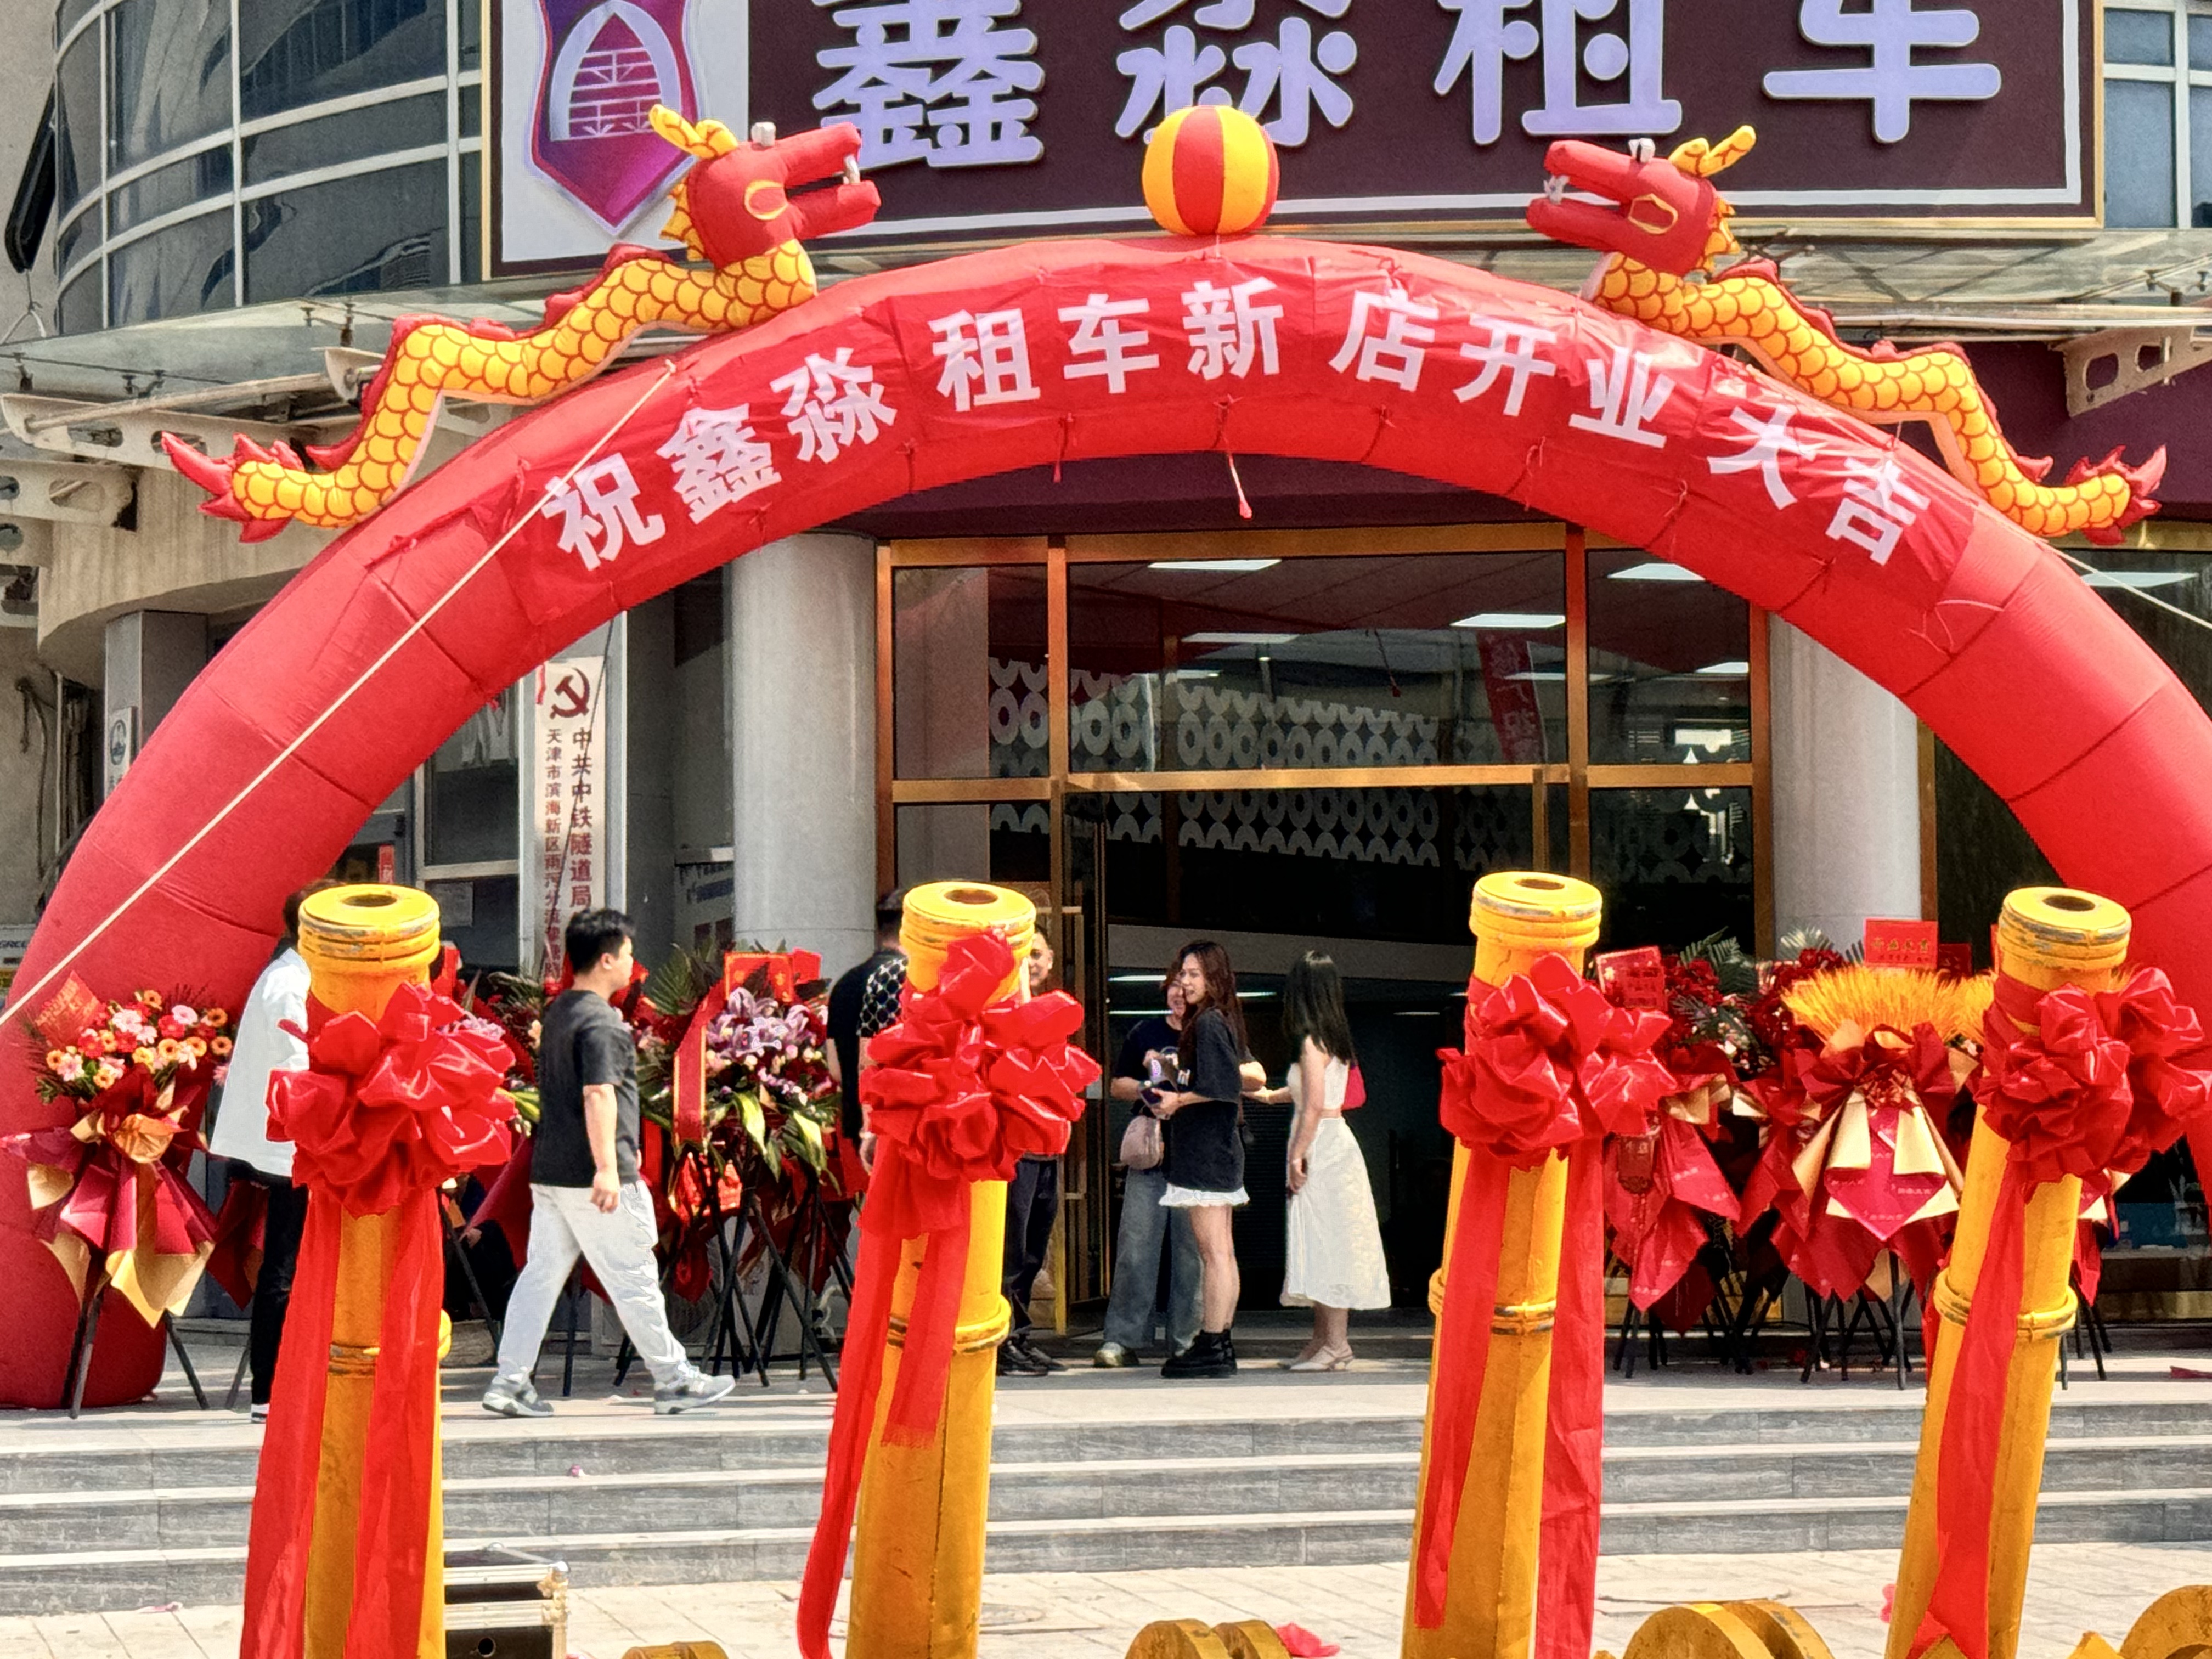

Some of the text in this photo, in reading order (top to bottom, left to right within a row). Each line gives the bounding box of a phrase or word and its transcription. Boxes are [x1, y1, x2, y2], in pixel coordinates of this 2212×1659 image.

[542, 276, 1931, 571] 祝鑫淼租车新店开业大吉
